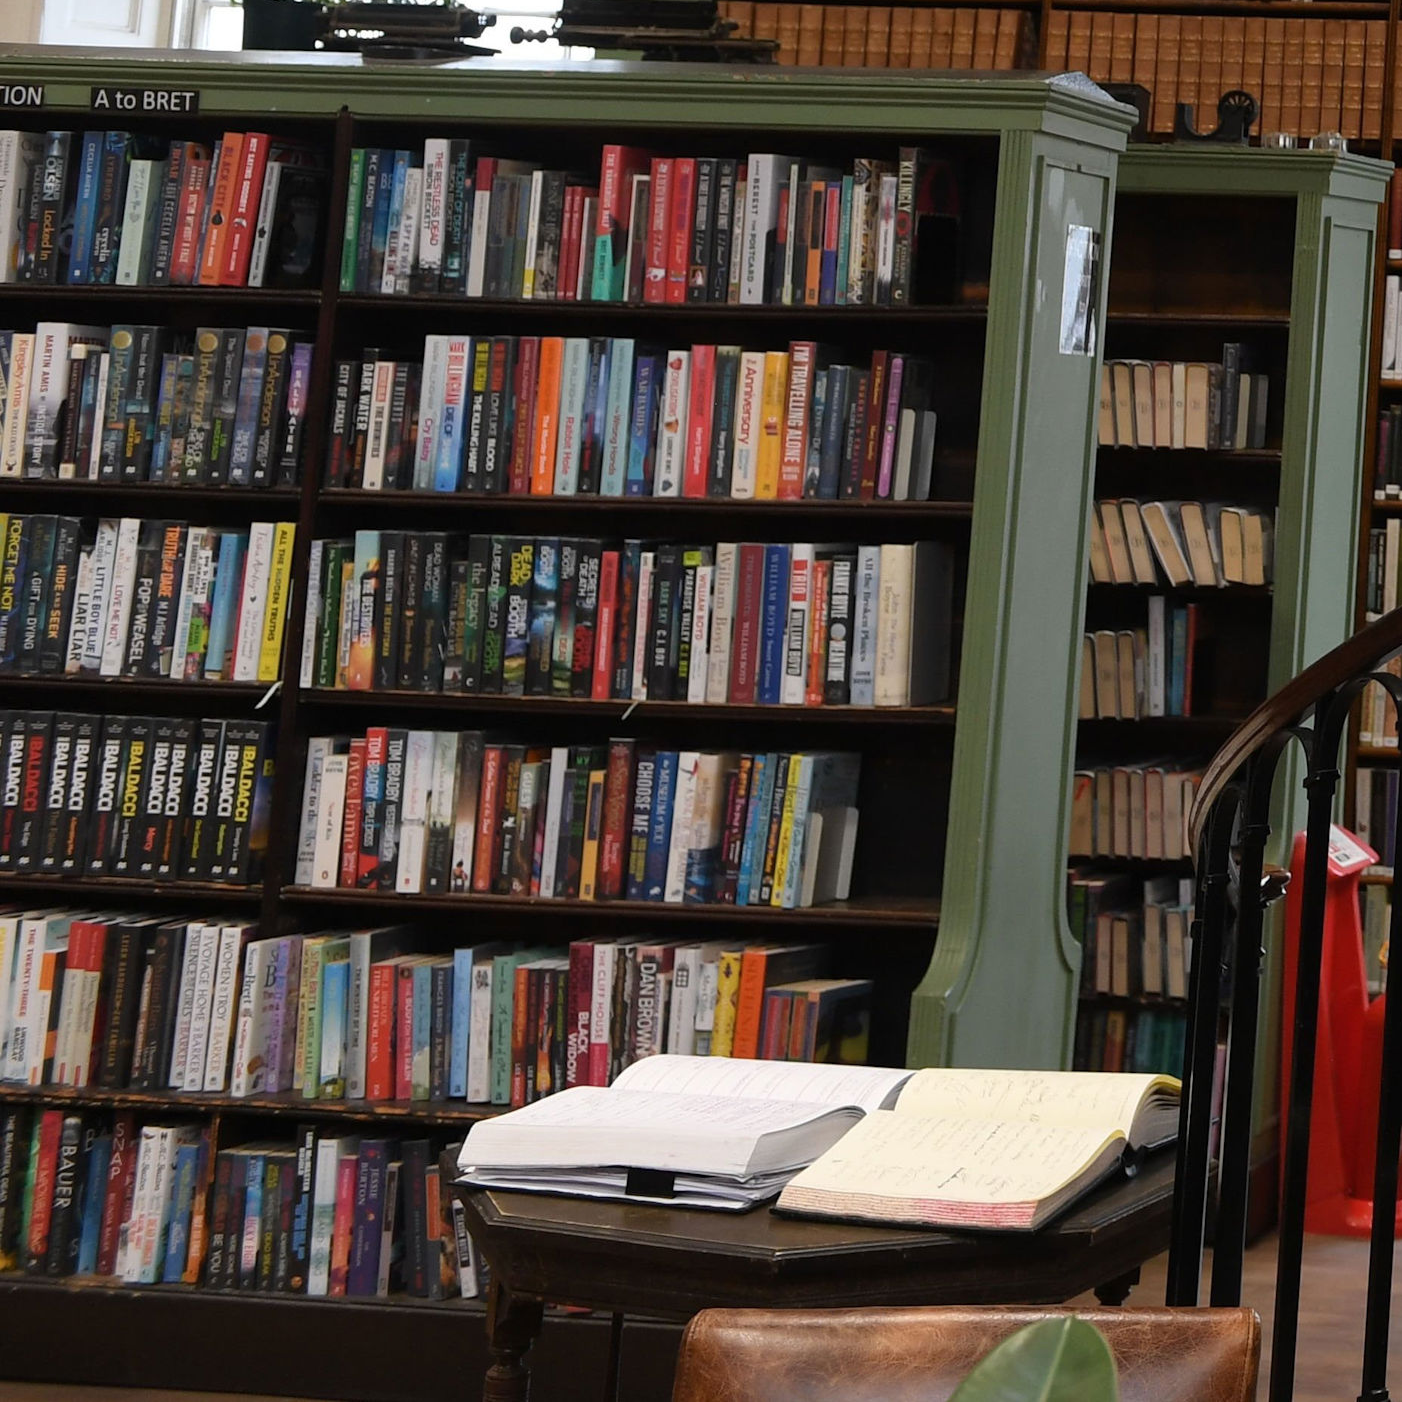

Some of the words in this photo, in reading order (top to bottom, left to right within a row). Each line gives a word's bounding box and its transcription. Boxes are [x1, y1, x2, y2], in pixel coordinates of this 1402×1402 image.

[94, 89, 110, 108] A
[115, 90, 137, 109] to
[143, 91, 195, 111] BRET
[433, 172, 443, 218] RESTLESS
[430, 220, 439, 246] DEAD
[747, 233, 757, 283] POSTCARD
[17, 339, 29, 378] Kingsley
[41, 334, 54, 368] MARTIN
[39, 371, 50, 393] AMIS
[338, 364, 349, 385] CITY
[361, 363, 373, 391] DARK
[737, 366, 758, 445] Anniversary
[788, 365, 808, 426] TRAVELLING
[34, 405, 47, 434] INSIDE
[356, 394, 370, 431] WATER
[563, 416, 575, 448] Rabbit
[784, 428, 802, 464] ALONE
[31, 436, 43, 465] STORY
[561, 451, 573, 476] Hole
[7, 519, 24, 565] FORGET
[161, 525, 182, 560] TRUTH
[279, 529, 288, 545] ALL
[277, 548, 287, 565] THE
[488, 542, 504, 595] ALREADY
[4, 566, 17, 585] ME
[30, 578, 43, 602] GIFT
[54, 564, 68, 591] HIDE
[93, 566, 107, 601] LITTLE
[472, 562, 487, 585] the
[577, 563, 589, 597] DEATH
[586, 557, 600, 610] SECRETS
[718, 549, 733, 609] William
[792, 568, 809, 596] TRIO
[0, 586, 15, 612] NOT
[112, 584, 125, 610] LOVE
[137, 577, 154, 605] POP
[696, 573, 708, 611] WILLIAM
[73, 593, 91, 626] LIAR
[90, 602, 102, 625] BOY
[110, 610, 122, 622] ME
[267, 607, 279, 642] TRUTHS
[487, 596, 500, 629] DEAD
[506, 594, 521, 639] BOOTH
[860, 591, 873, 625] Broken
[24, 617, 38, 650] DYING
[48, 610, 62, 640] SEEK
[86, 626, 99, 654] BLUE
[108, 623, 120, 640] NOT
[128, 611, 148, 664] WEASEL
[694, 614, 705, 642] BOYD
[789, 611, 805, 650] WILLIAM
[69, 629, 84, 662] LIAR
[857, 627, 870, 663] Places
[787, 650, 802, 676] BOYD
[368, 736, 383, 763] TOM
[388, 738, 404, 763] TOM
[366, 764, 381, 800] BRADBY
[385, 763, 401, 803] BRADBY
[635, 761, 655, 812] CHOOSE
[632, 814, 650, 834] ME
[28, 927, 37, 946] THE
[185, 934, 200, 976] SILENCE
[198, 940, 215, 985] VOYAGE
[219, 940, 236, 985] WOMEN
[19, 948, 36, 1017] TWENTY-THREE
[638, 962, 657, 996] DAN
[197, 989, 210, 1022] HOME
[216, 994, 230, 1022] TROY
[577, 1011, 590, 1055] BLACK
[635, 997, 654, 1057] BROWN
[175, 1028, 190, 1068] BARKER
[189, 1033, 204, 1074] BARKER
[210, 1032, 224, 1072] BARKER
[566, 1032, 578, 1083] WIDOW
[110, 1122, 127, 1181] SNAP
[52, 1145, 78, 1209] BAUER
[358, 1161, 369, 1206] BURTON
[369, 1167, 381, 1199] JESSIE
[213, 1233, 224, 1246] BE
[209, 1250, 223, 1273] YOU
